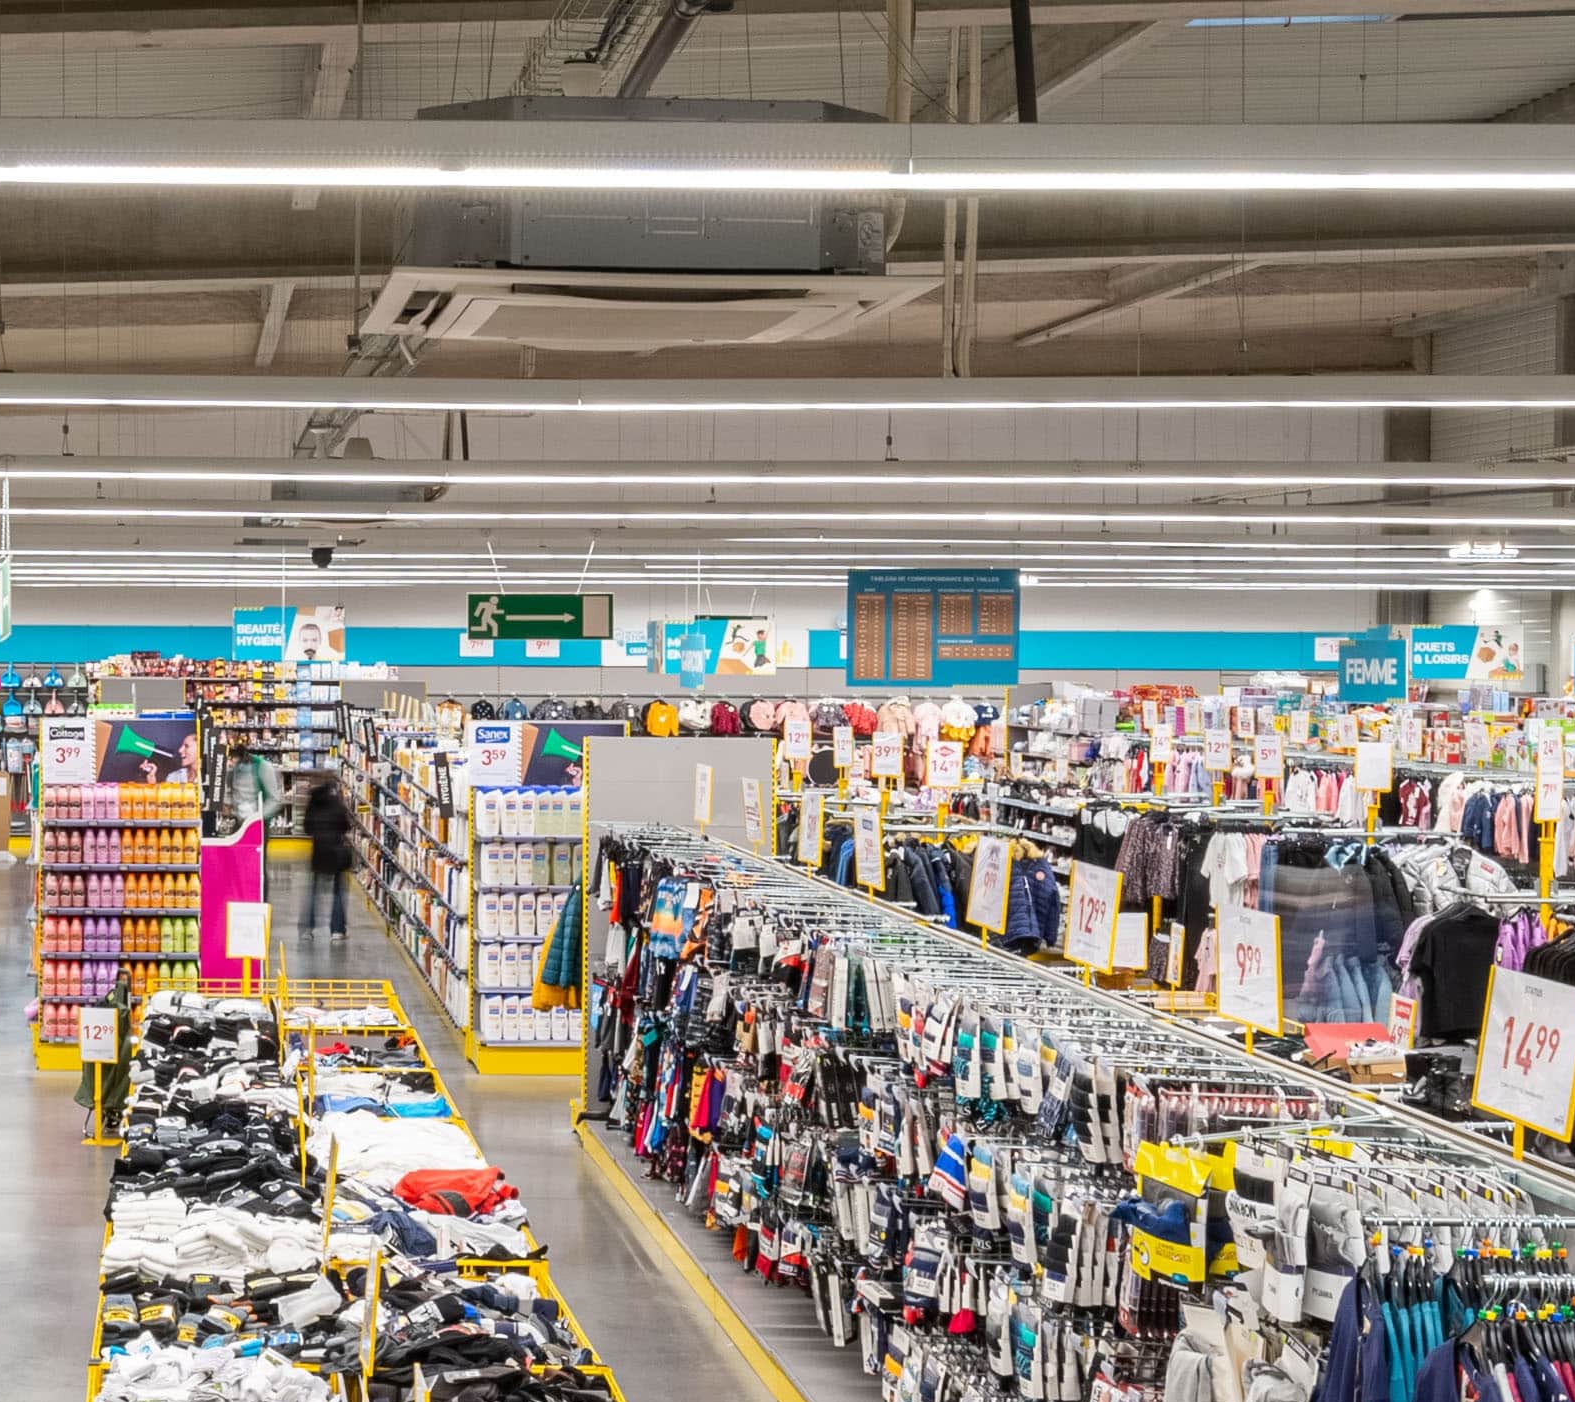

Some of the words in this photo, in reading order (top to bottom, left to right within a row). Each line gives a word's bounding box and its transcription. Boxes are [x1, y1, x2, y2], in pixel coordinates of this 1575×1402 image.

[237, 622, 281, 635] BEAUTÉ
[1414, 642, 1455, 654] JOUETS
[1423, 654, 1469, 665] LOISIRS
[1346, 657, 1398, 685] FEMME
[478, 727, 510, 743] Sanex
